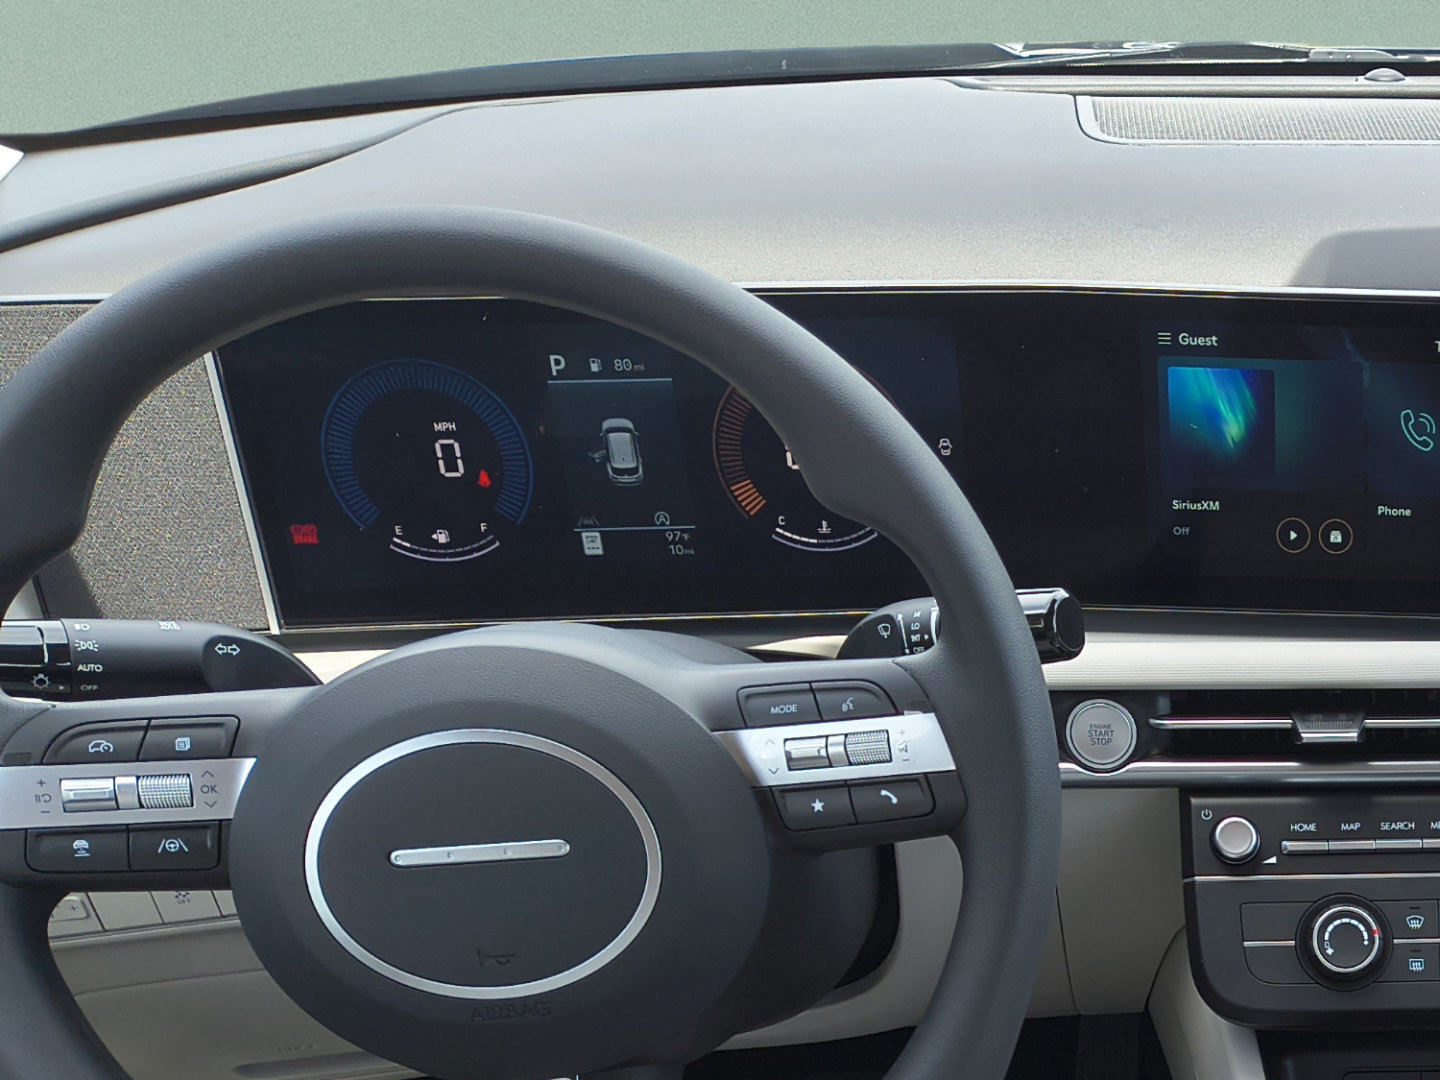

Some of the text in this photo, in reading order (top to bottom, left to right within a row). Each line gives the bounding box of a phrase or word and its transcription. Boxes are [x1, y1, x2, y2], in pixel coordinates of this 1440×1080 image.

[1178, 333, 1218, 347] Guest
[549, 354, 566, 376] P
[433, 422, 457, 432] MPH
[435, 439, 464, 477] 0
[1172, 499, 1220, 512] SiriusXM
[1377, 506, 1411, 518] Phone
[778, 515, 786, 526] C
[394, 525, 403, 535] E
[480, 522, 488, 533] F
[1173, 526, 1190, 537] Off
[77, 663, 103, 672] AUTO
[80, 684, 99, 692] OFF
[770, 704, 798, 714] MODE
[1088, 729, 1115, 738] START
[1090, 737, 1113, 746] STOP
[201, 785, 218, 794] OK
[1290, 822, 1317, 832] HOME
[1341, 822, 1361, 831] MAP
[1380, 821, 1415, 831] SEARCH
[470, 1000, 553, 1023] AIRBAG
